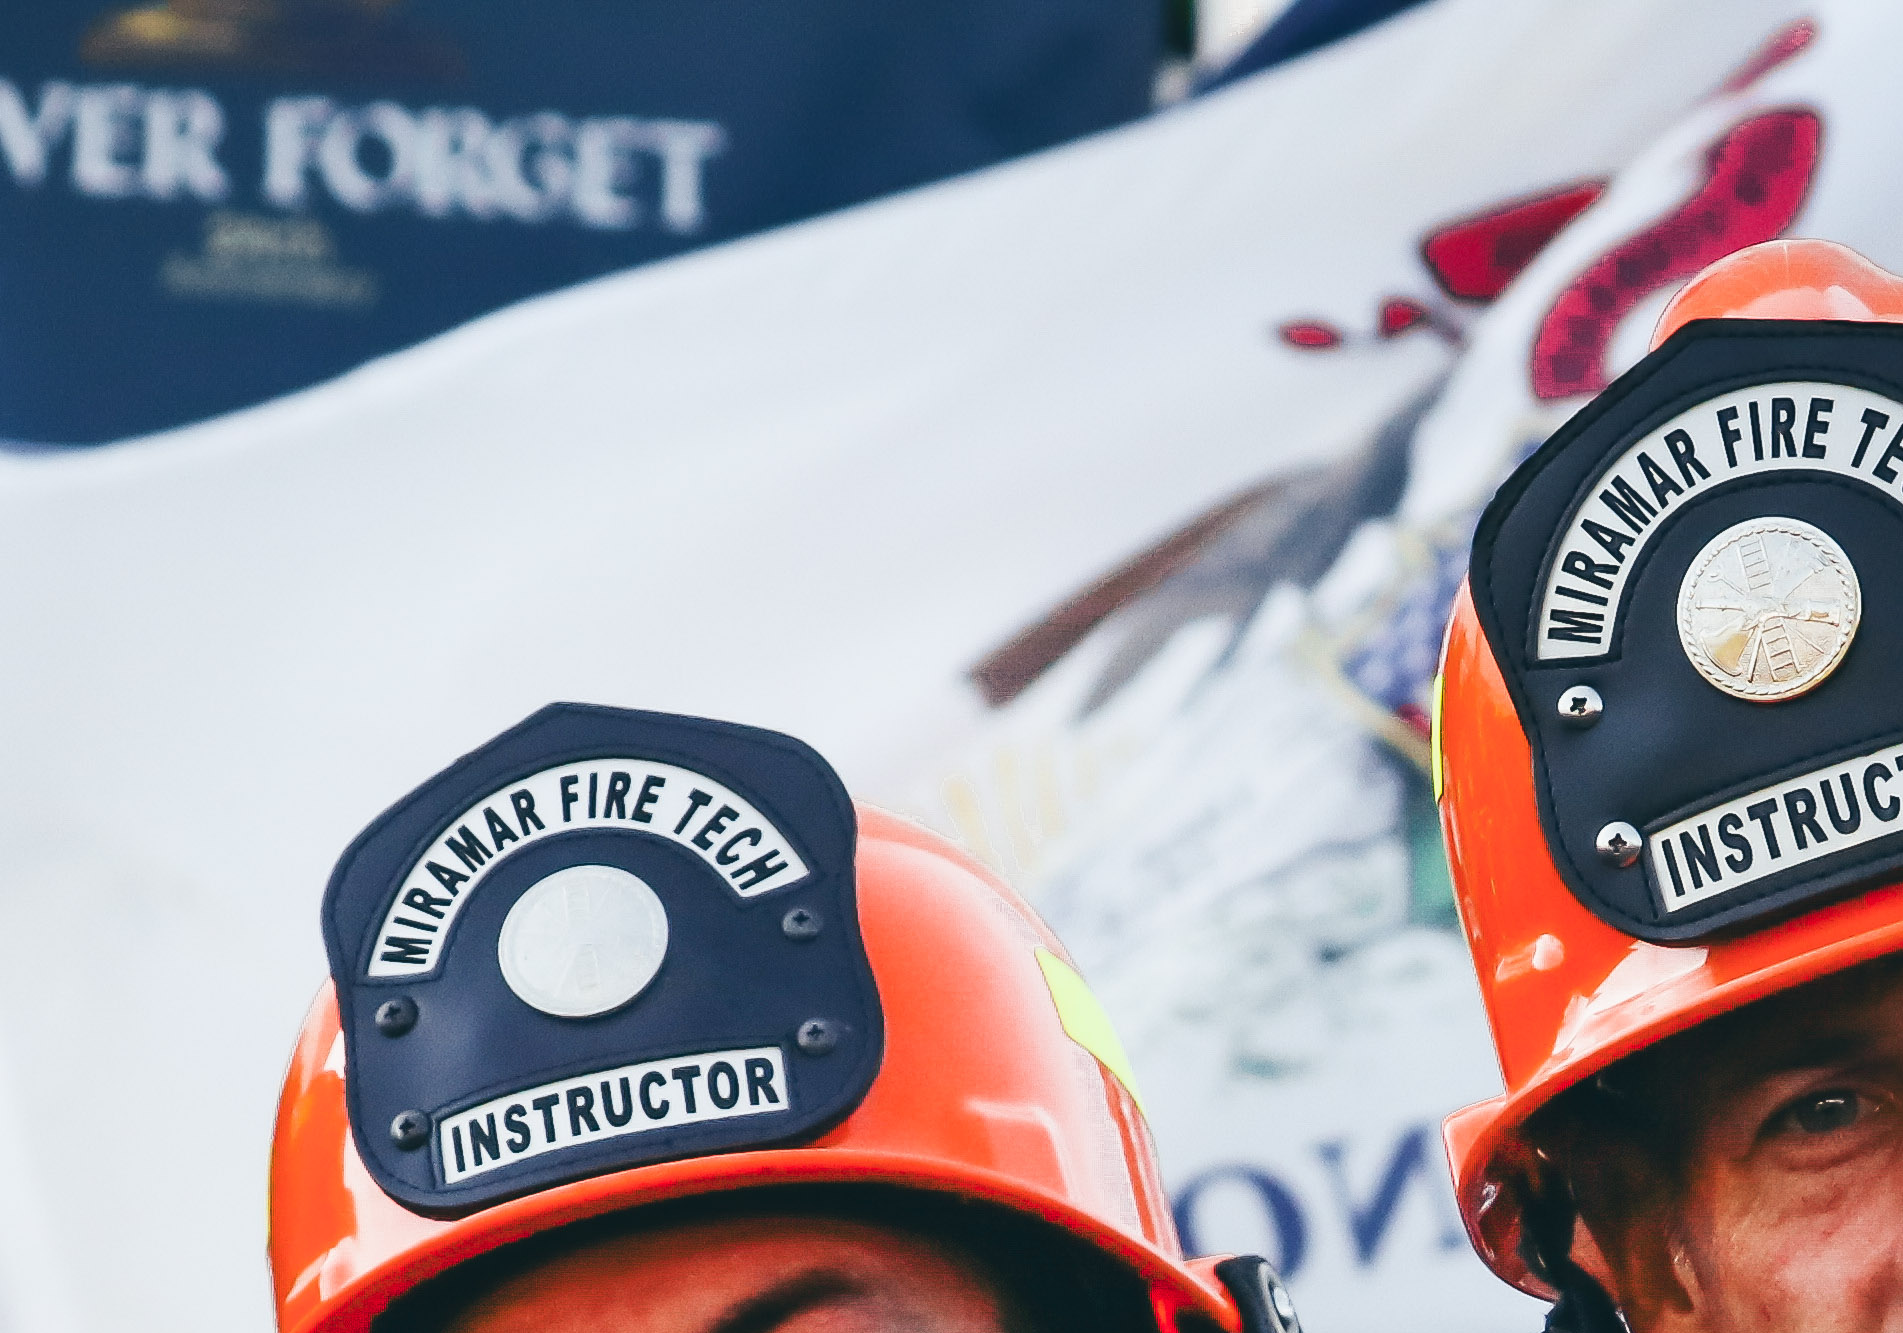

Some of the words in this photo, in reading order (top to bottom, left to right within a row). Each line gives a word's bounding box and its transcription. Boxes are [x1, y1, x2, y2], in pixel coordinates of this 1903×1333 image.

[264, 93, 726, 232] FORGET
[1548, 427, 1710, 645] MIRAMAR
[1717, 397, 1835, 468] FIRE
[381, 788, 546, 965] MIRAMAR
[560, 771, 666, 822] FIRE
[672, 787, 788, 893] TECH
[452, 1057, 780, 1173] INSTRUCTOR
